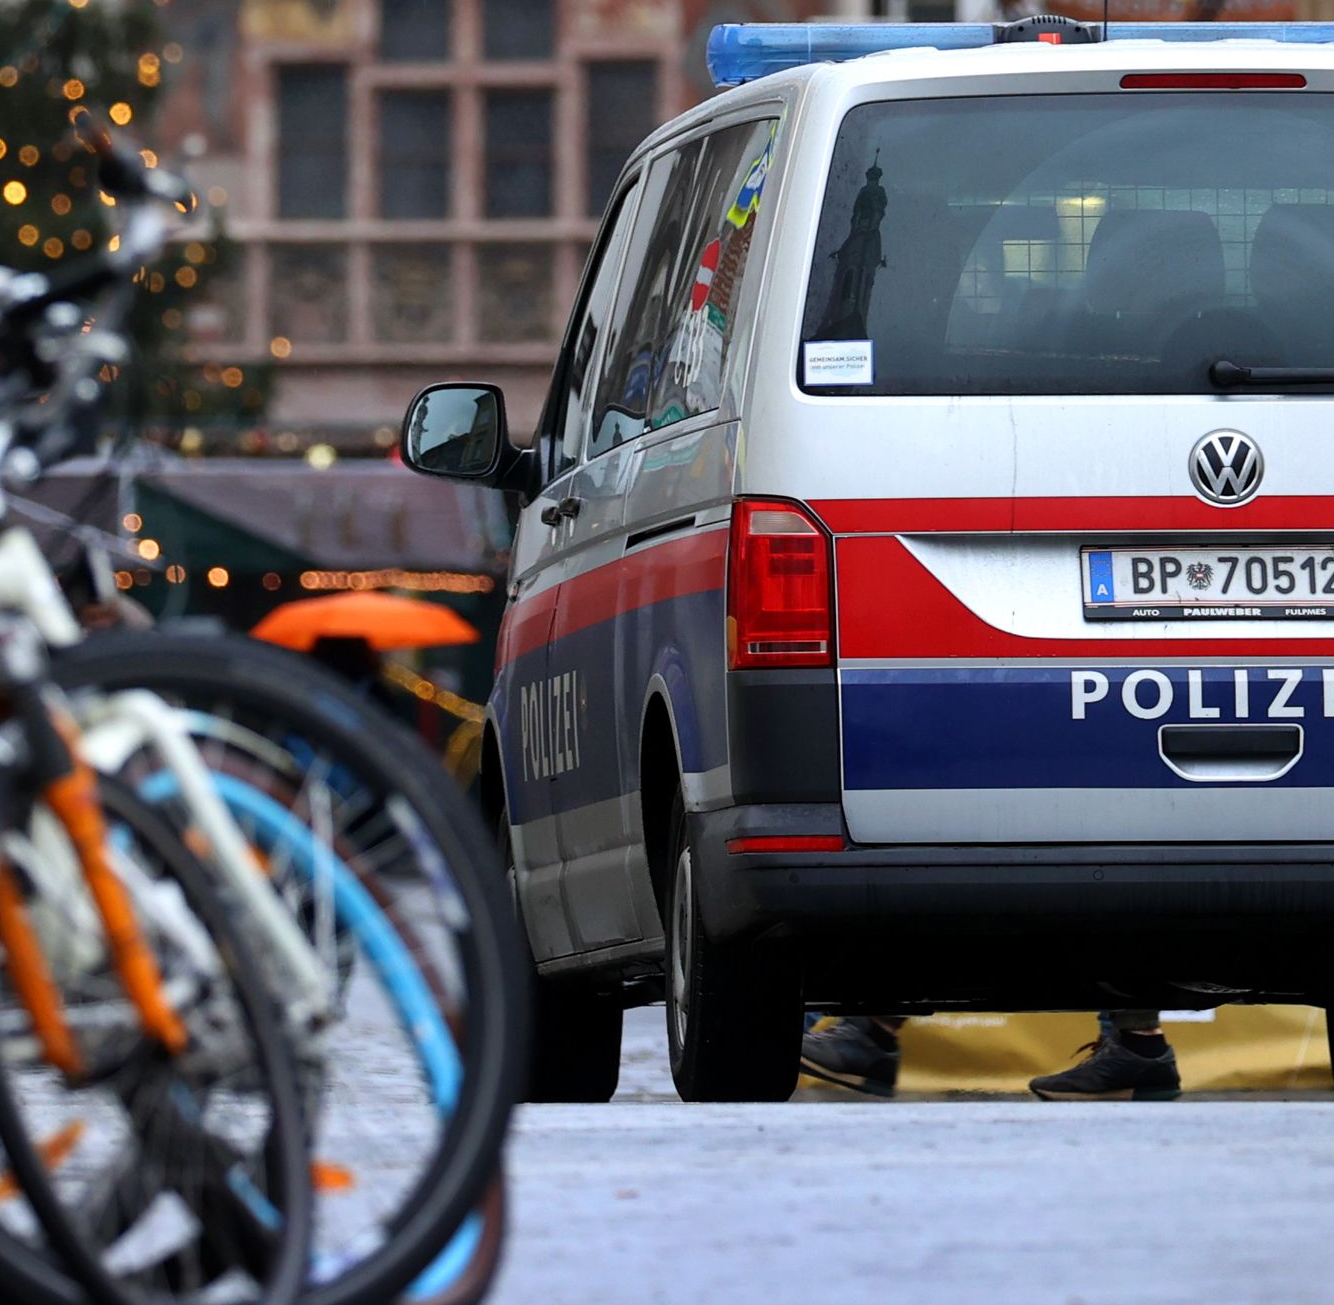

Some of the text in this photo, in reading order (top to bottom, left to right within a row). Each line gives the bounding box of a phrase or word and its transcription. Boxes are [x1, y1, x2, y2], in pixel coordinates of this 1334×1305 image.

[1131, 556, 1183, 595] BP
[1096, 583, 1109, 596] A
[1132, 607, 1327, 617] AUTO PAULWEBER FULPMES
[520, 670, 581, 782] POLIZEI
